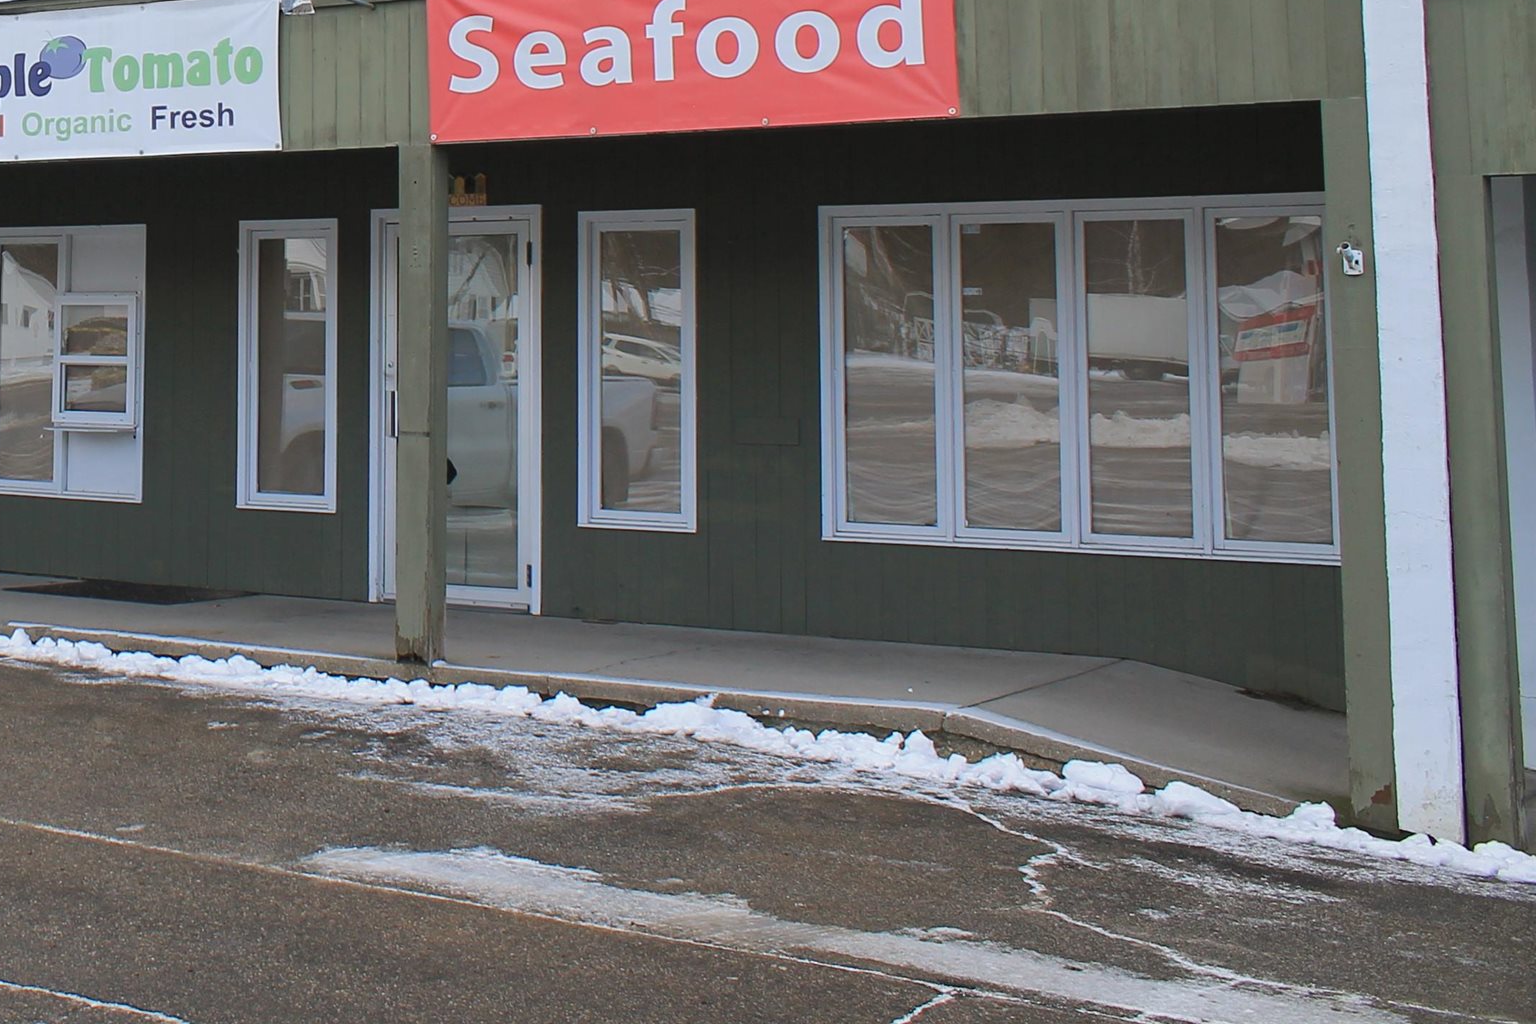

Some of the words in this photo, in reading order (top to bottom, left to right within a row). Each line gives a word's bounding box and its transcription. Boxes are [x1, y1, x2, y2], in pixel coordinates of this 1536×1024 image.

[81, 36, 264, 93] Tomato
[21, 108, 132, 141] Organic
[150, 102, 234, 131] Fresh
[449, 194, 485, 206] COME
